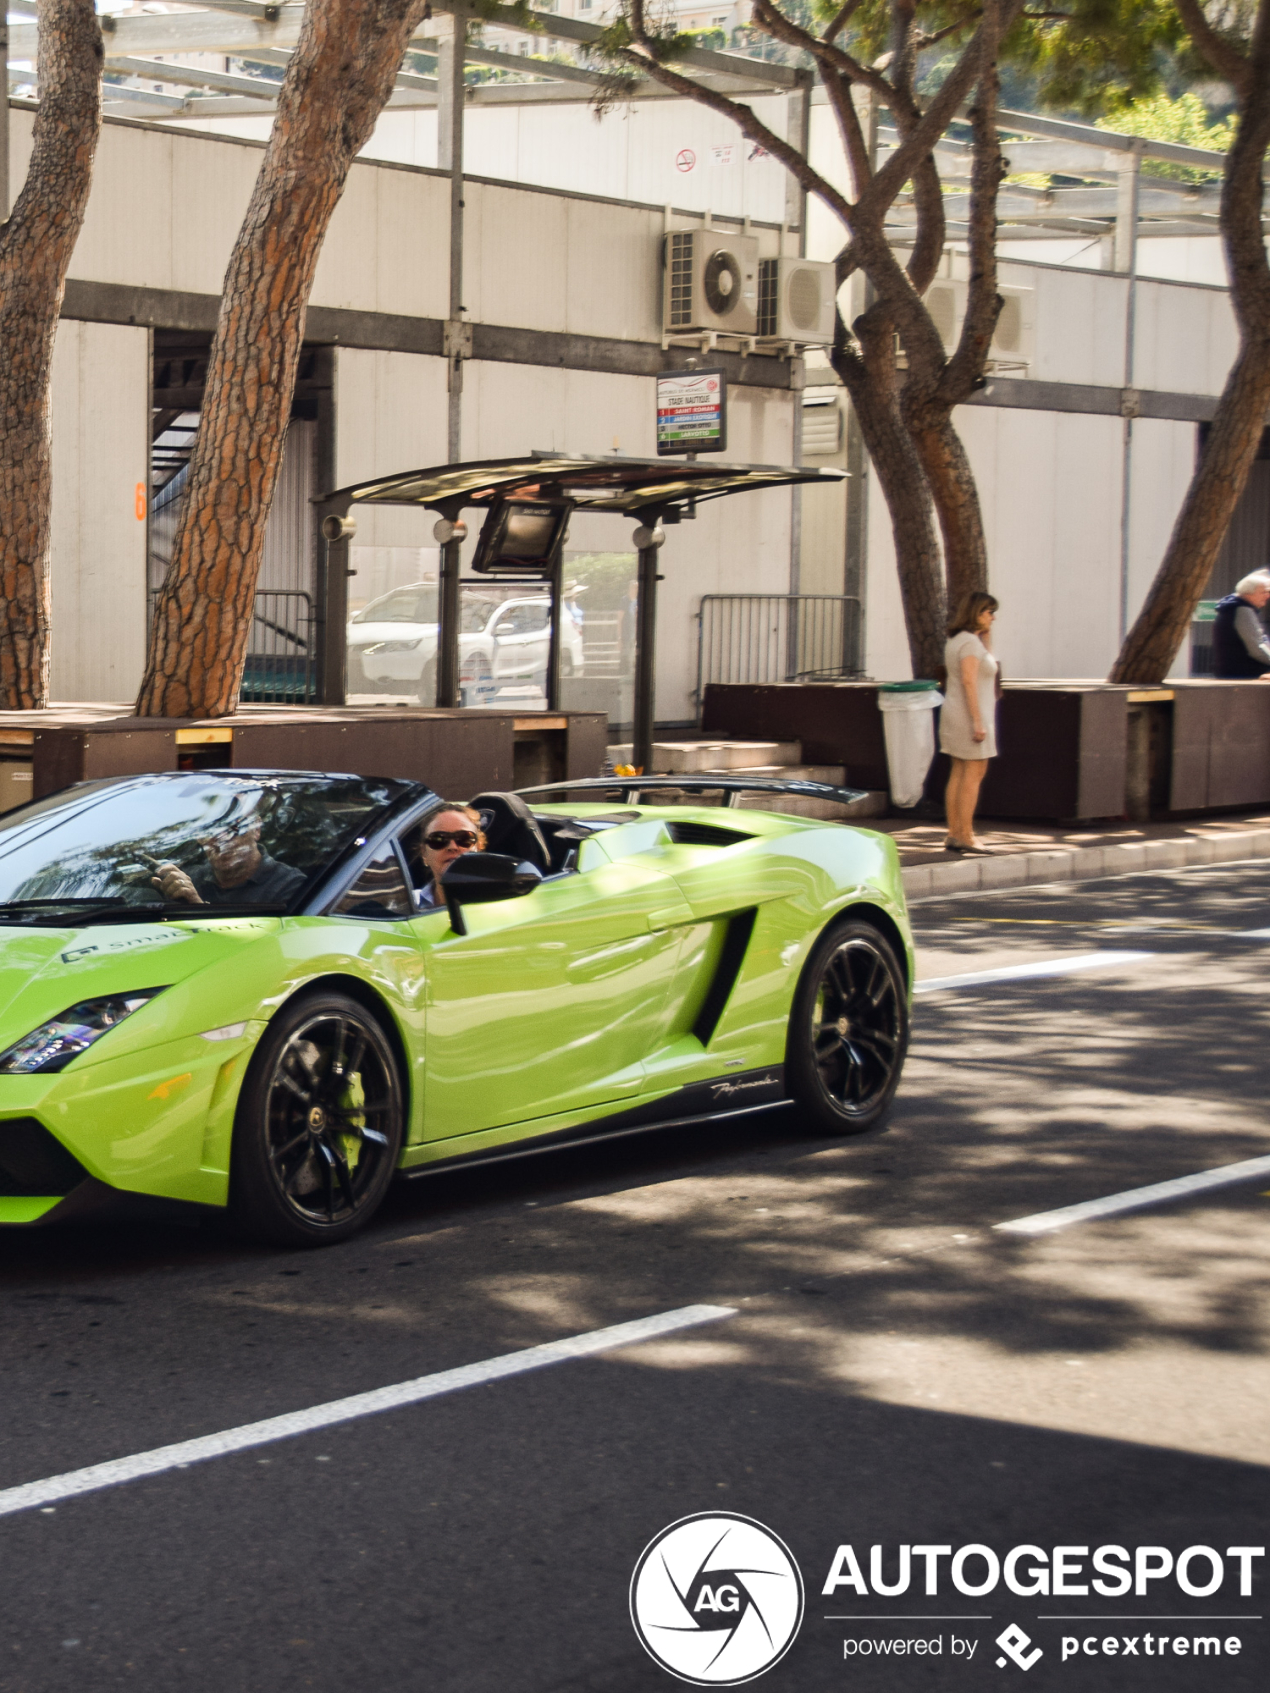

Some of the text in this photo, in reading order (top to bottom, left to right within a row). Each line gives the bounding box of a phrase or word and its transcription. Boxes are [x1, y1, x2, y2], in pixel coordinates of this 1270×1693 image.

[668, 395, 710, 405] STADE NAUTIQUE
[135, 481, 147, 522] 6
